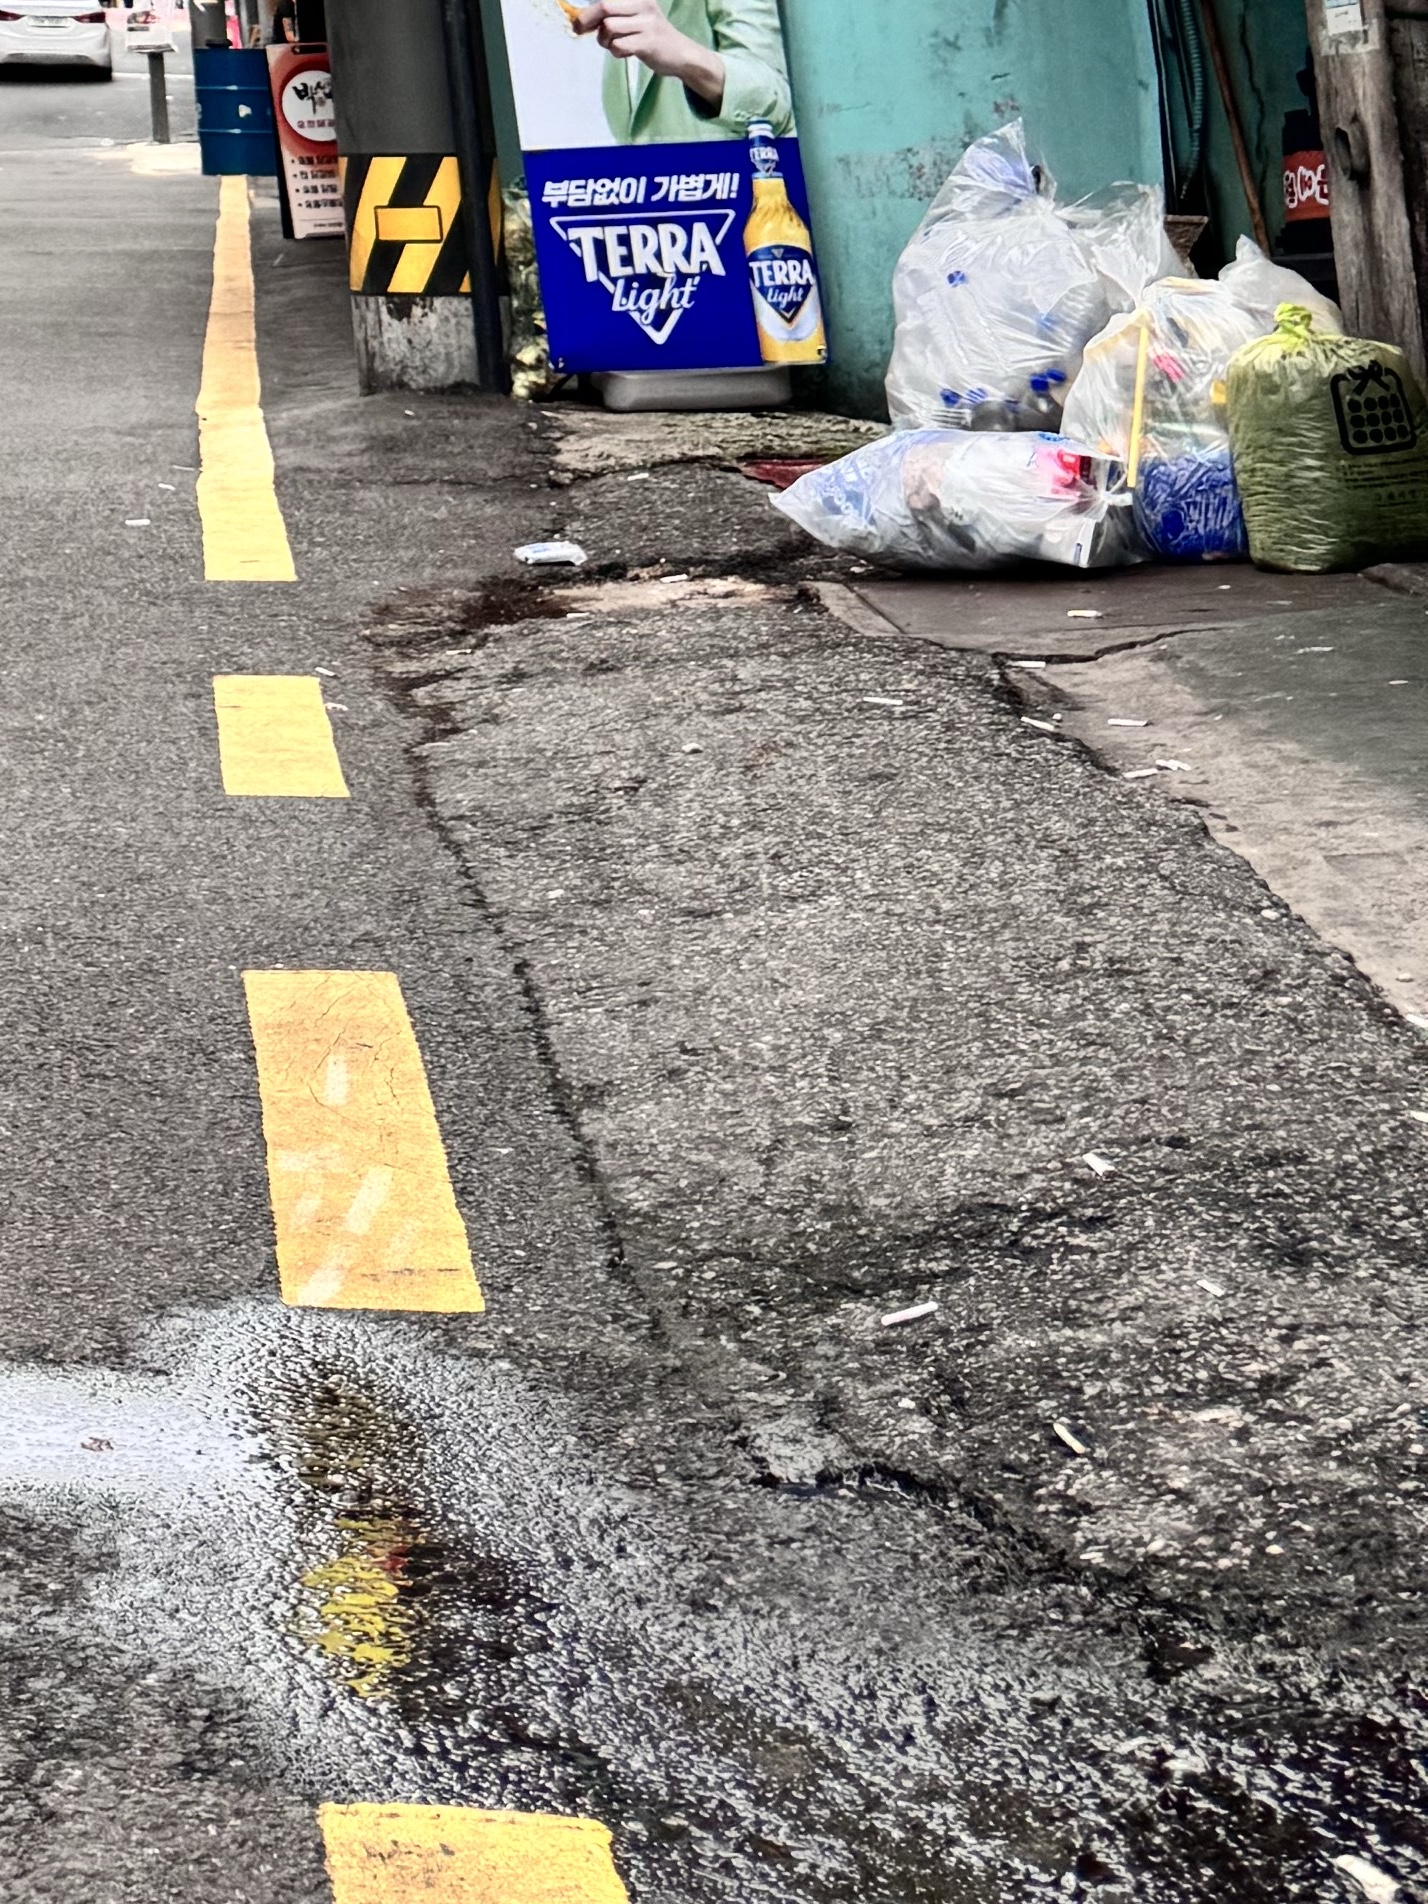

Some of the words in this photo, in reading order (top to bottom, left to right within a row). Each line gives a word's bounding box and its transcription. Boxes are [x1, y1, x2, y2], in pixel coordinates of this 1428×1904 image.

[542, 177, 645, 208] 부담없이
[651, 172, 740, 203] 가볍게!
[567, 223, 726, 282] TERRA
[749, 257, 815, 287] TERRA
[611, 270, 699, 323] Light
